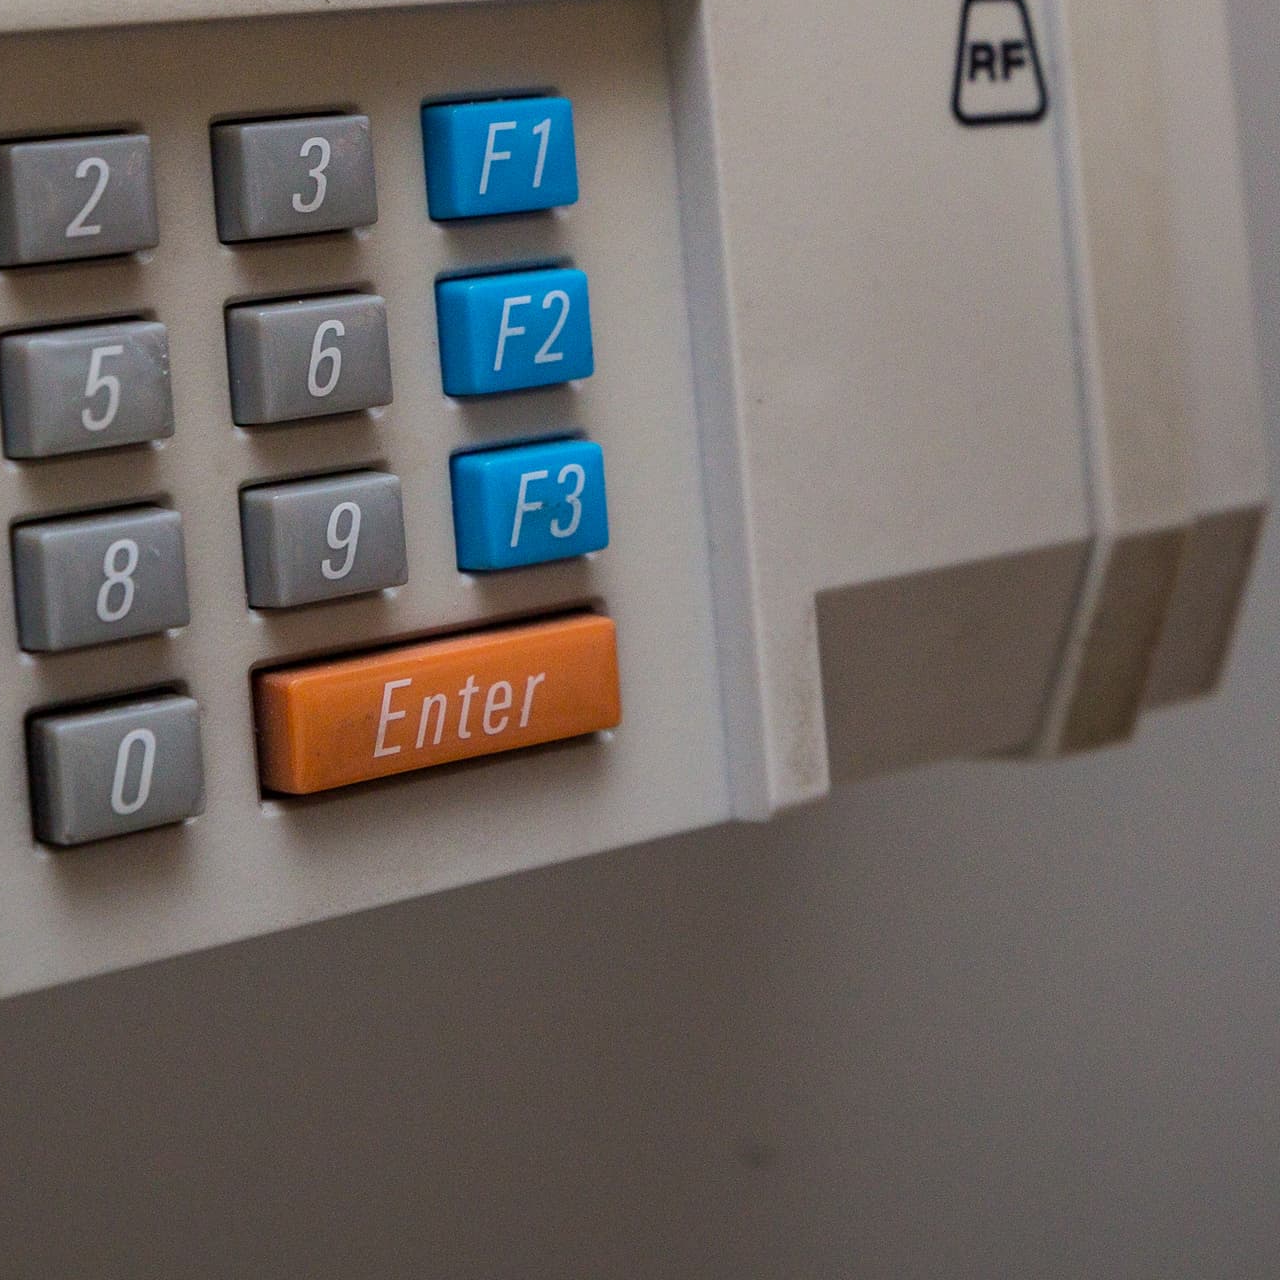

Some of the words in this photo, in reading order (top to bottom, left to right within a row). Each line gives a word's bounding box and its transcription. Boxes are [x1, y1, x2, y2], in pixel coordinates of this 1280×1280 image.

[968, 40, 1026, 82] RF
[64, 156, 109, 238] 2
[292, 136, 331, 213] 3
[478, 117, 553, 196] F1
[306, 319, 346, 398] 6
[493, 289, 572, 372] F2
[81, 345, 124, 432] 5
[321, 501, 362, 581] 9
[510, 462, 588, 548] F3
[95, 538, 140, 623] 8
[372, 671, 547, 759] Enter
[110, 727, 157, 815] 0
